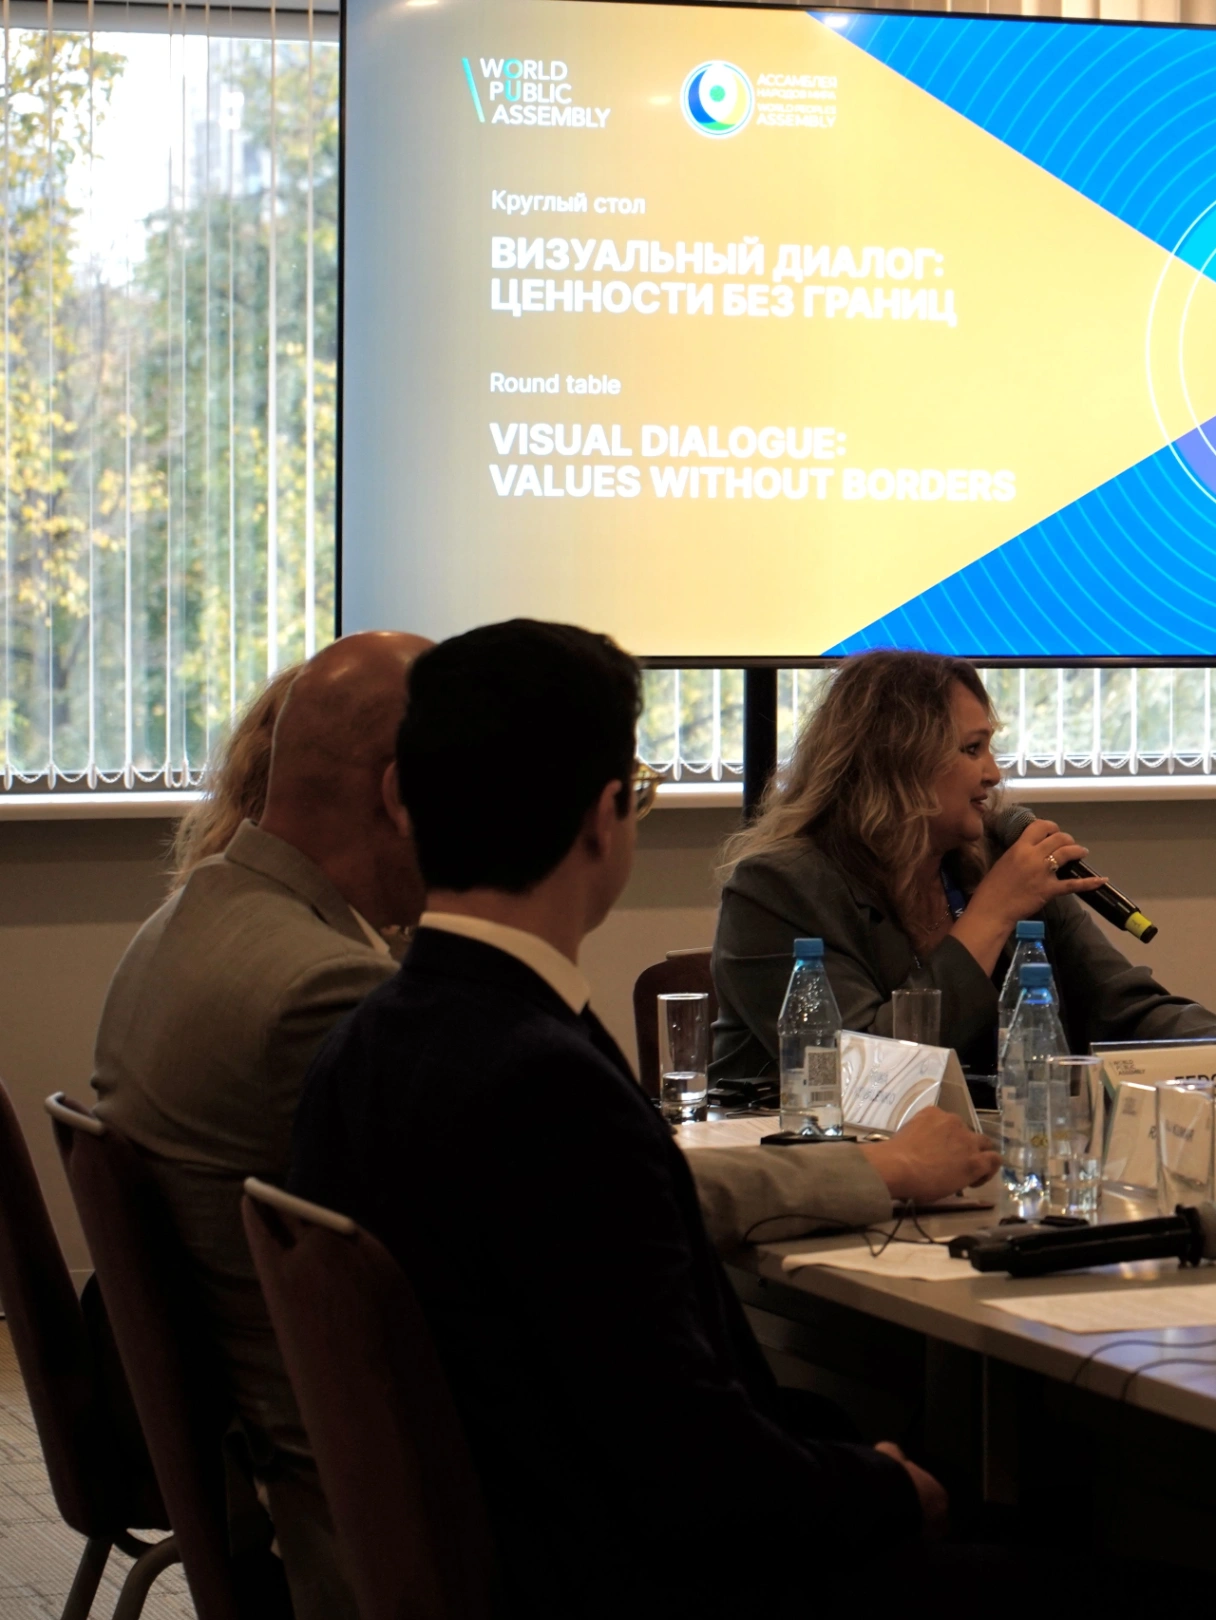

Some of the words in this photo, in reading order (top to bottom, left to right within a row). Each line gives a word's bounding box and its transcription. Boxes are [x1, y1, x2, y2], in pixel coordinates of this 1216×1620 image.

[479, 58, 568, 81] WORLD
[489, 80, 573, 105] PUBLIC
[491, 103, 612, 129] ASSEMBLY
[756, 113, 837, 128] ASSEMBLY
[491, 189, 588, 215] Круглый
[593, 197, 646, 214] стол
[491, 236, 765, 275] ВИЗУАЛЬНЫЙ
[772, 244, 945, 283] ДИАЛОГ:
[491, 278, 714, 317] ЦЕННОСТИ
[723, 283, 795, 317] БЕЗ
[803, 285, 958, 328] ГРАНИЦ
[490, 372, 560, 394] Round
[566, 374, 621, 395] table
[489, 423, 633, 456] VISUAL
[641, 425, 847, 459] DIALOGUE:
[488, 464, 641, 498] VALUES
[650, 466, 835, 499] WITHOUT
[842, 467, 1017, 502] BORDERS
